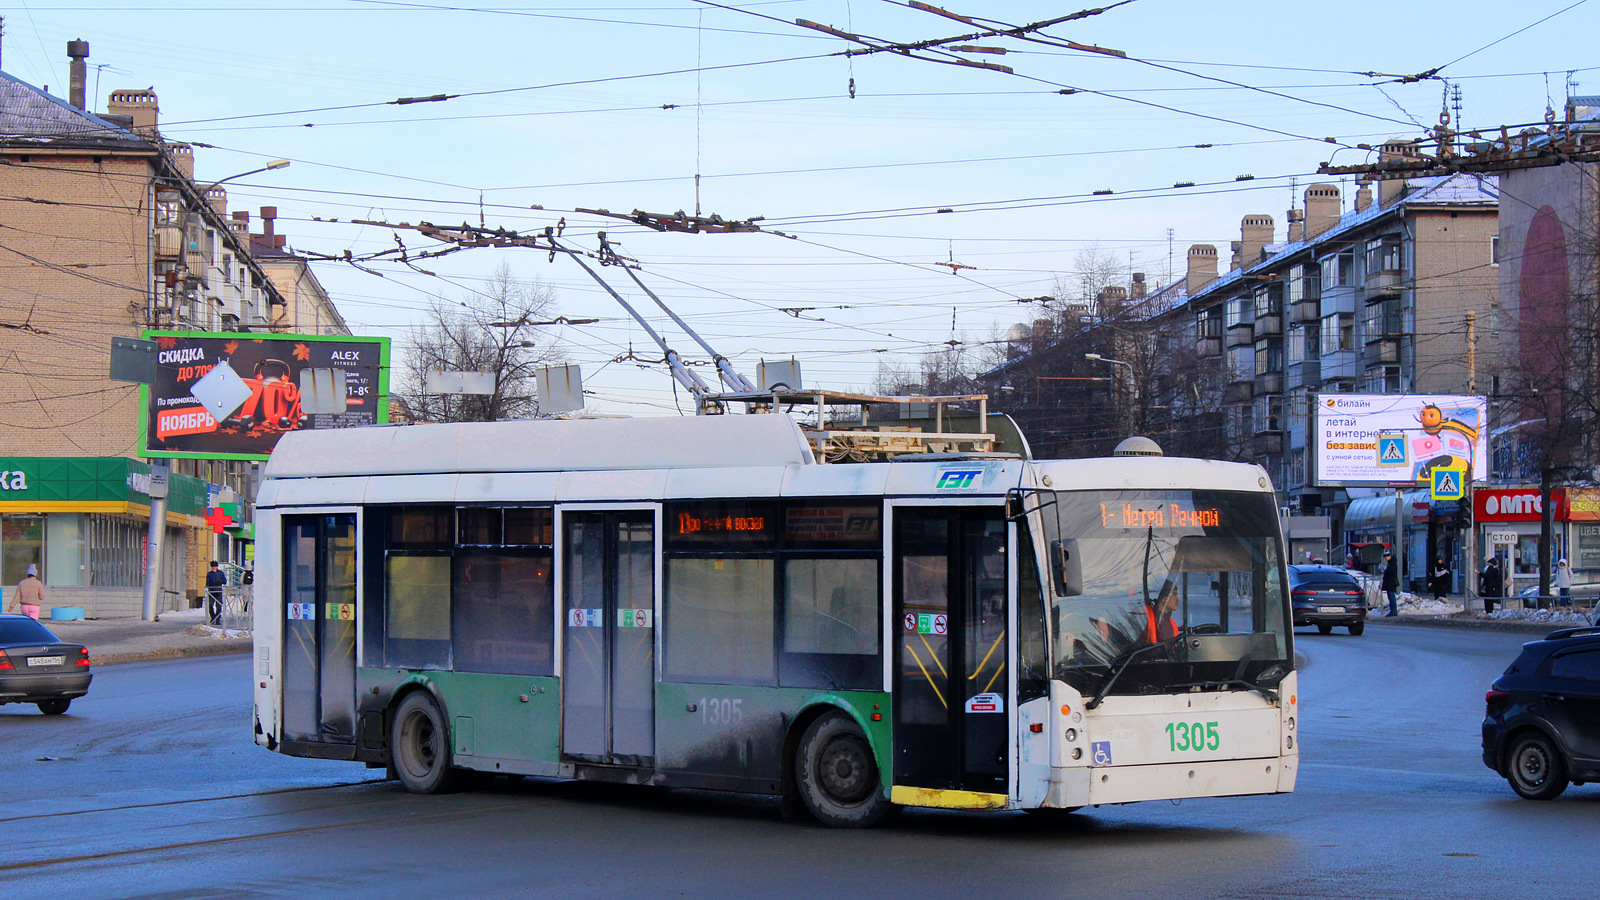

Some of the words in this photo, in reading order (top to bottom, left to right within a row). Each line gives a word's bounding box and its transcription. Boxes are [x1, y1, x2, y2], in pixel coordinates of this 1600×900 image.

[158, 347, 205, 364] СКИДКА
[331, 351, 360, 360] ALEX
[176, 366, 194, 382] ДО
[157, 398, 166, 406] По
[1337, 399, 1371, 408] билайн
[161, 411, 215, 431] НОЯБРЬ
[1326, 417, 1357, 427] летай
[1326, 440, 1345, 450] без
[1348, 442, 1377, 450] завис
[1122, 503, 1164, 527] Метро
[1170, 503, 1219, 527] Речной
[700, 698, 743, 725] 1305
[1165, 721, 1220, 752] 1305
